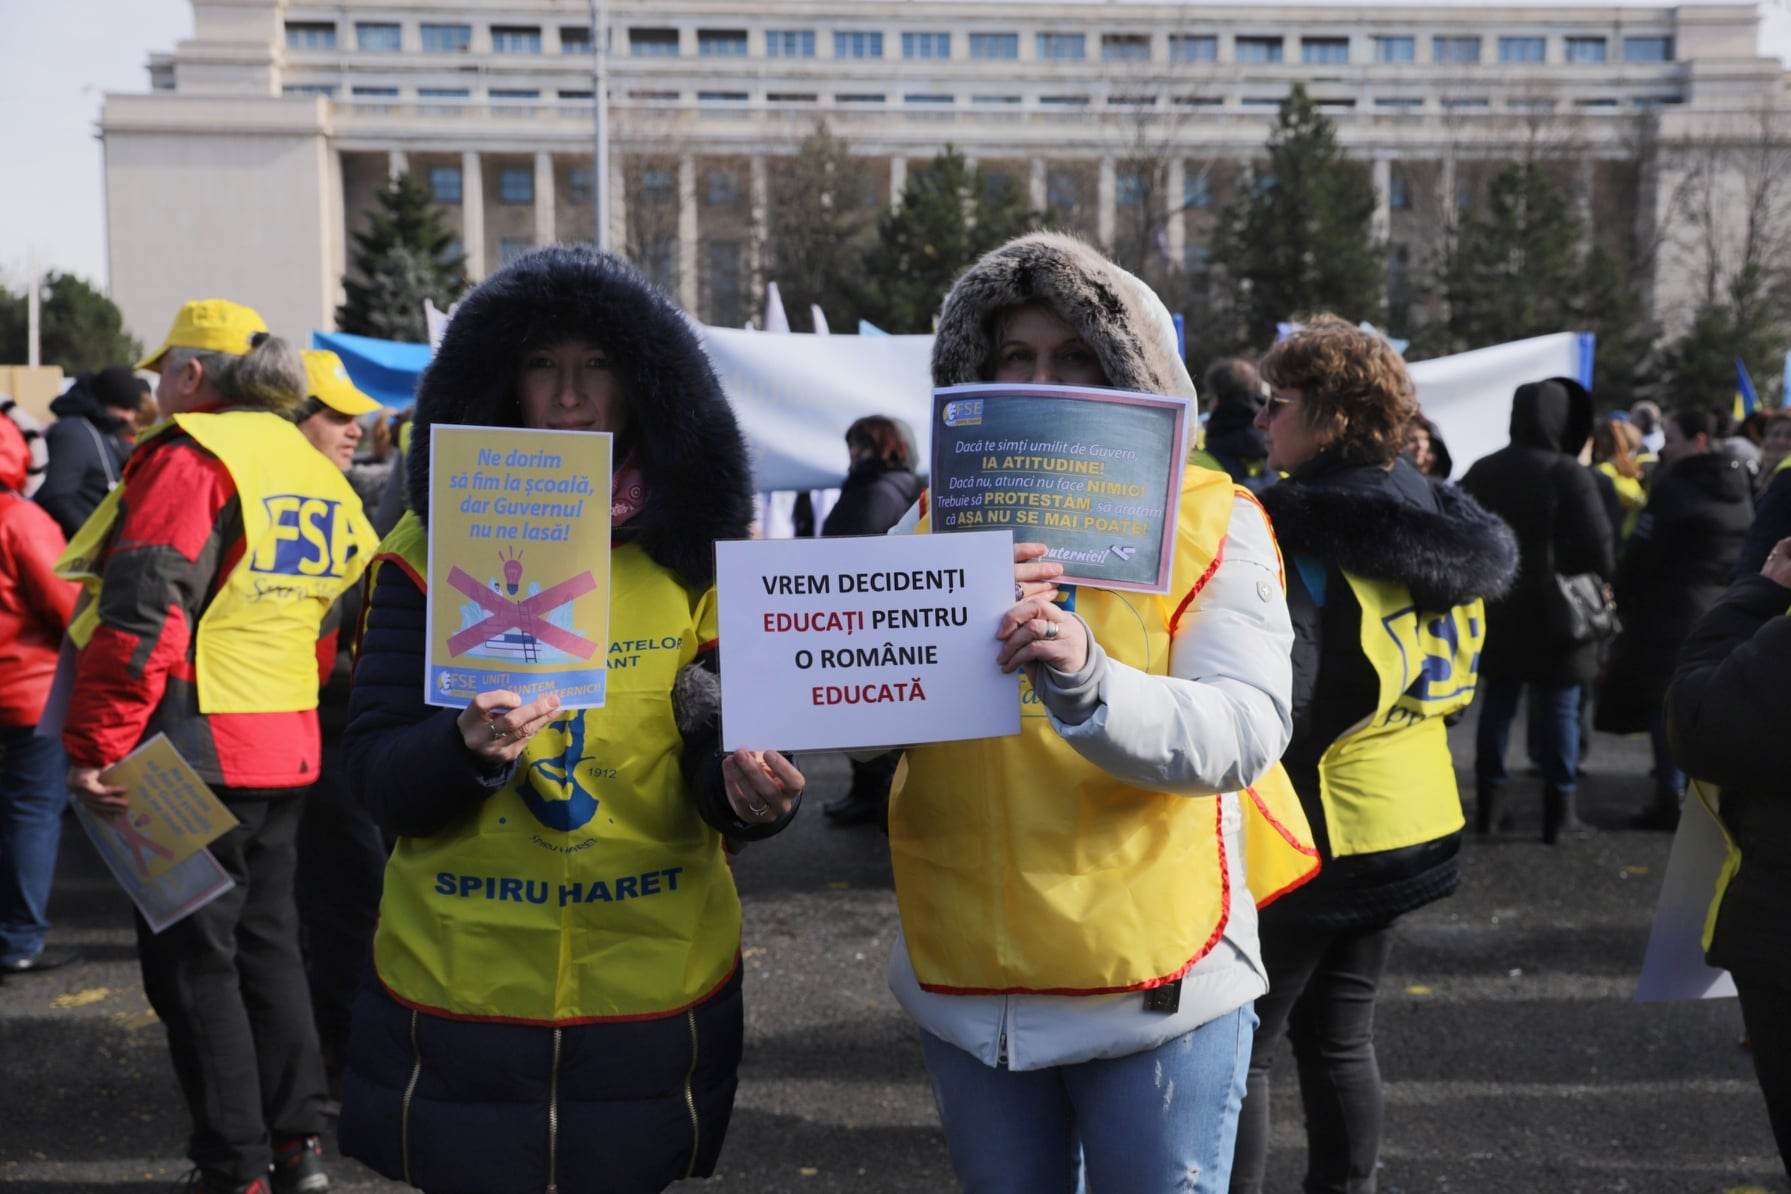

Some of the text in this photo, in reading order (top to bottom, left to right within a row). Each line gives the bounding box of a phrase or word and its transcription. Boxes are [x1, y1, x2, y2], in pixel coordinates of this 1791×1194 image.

[955, 440, 982, 453] Dacă
[985, 441, 995, 452] te
[998, 439, 1028, 454] simți
[1030, 440, 1068, 453] umilit
[1070, 443, 1086, 455] de
[478, 448, 562, 468] Ne dorim
[982, 456, 1105, 475] IA ATITUDINE!
[449, 471, 594, 496] să fim la școală,
[949, 475, 974, 490] Dacă
[976, 478, 992, 489] nu,
[995, 475, 1035, 488] atunci
[1036, 479, 1053, 489] nu
[1056, 477, 1084, 491] face
[460, 496, 584, 518] dar Guvernul
[937, 495, 972, 508] Trebuie
[972, 493, 983, 505] să
[470, 522, 570, 541] nu ne lasă!
[946, 510, 1149, 537] că AȘA NU SE MAI POATE!
[762, 568, 965, 595] VREM DECIDENȚI
[764, 606, 967, 635] EDUCAȚI PENTRU
[795, 642, 938, 669] O ROMÂNIE
[450, 673, 477, 689] FSE
[812, 678, 926, 705] EDUCATĂ
[587, 767, 617, 779] 1912
[434, 867, 683, 907] SPIRU HARET
